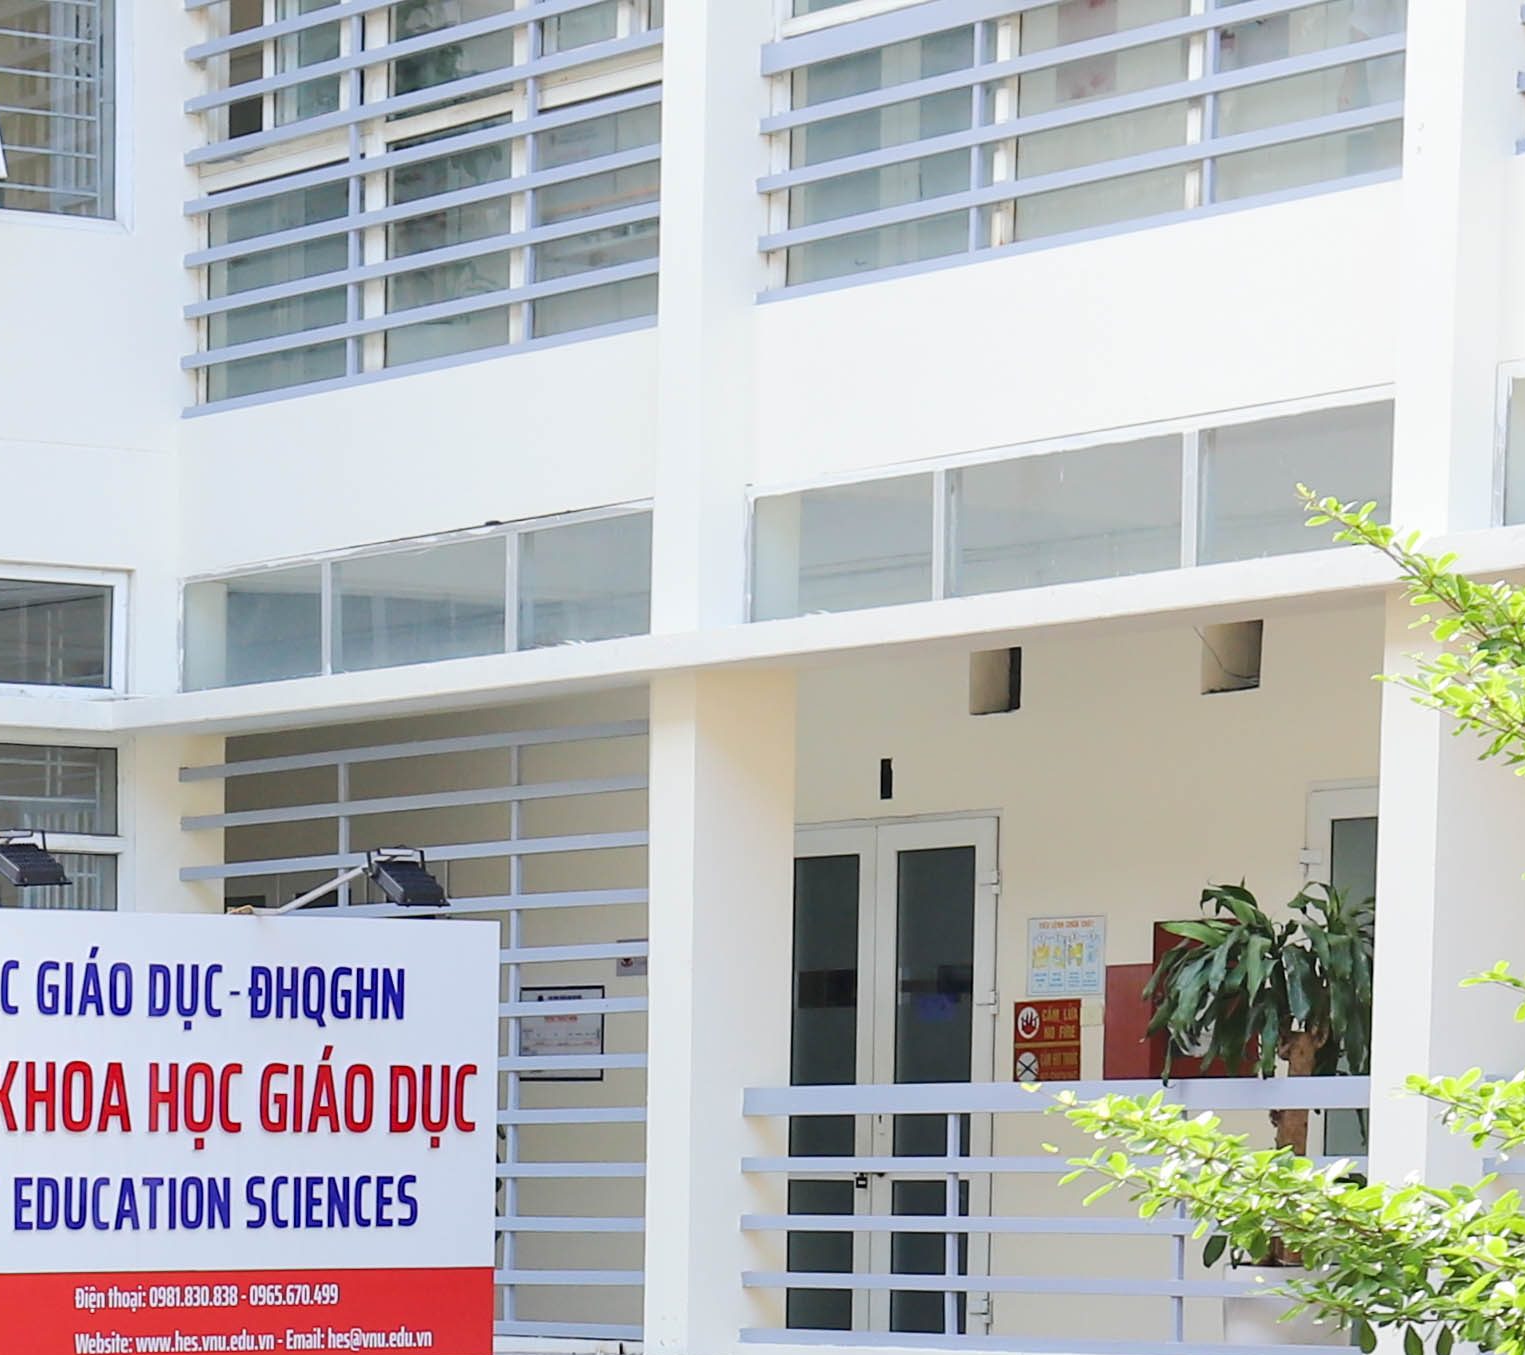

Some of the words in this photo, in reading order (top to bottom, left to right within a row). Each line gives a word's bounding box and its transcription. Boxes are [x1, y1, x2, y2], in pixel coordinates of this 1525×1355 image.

[37, 946, 133, 1017] GIÁO
[148, 963, 223, 1031] DỤC
[248, 965, 405, 1027] ĐHQGHN
[148, 1062, 243, 1151] HỌC
[259, 1045, 374, 1134] GIÁO
[389, 1063, 478, 1149] DỤC
[13, 1175, 231, 1231] EDUCATION
[246, 1174, 418, 1230] SCIENCES
[74, 1285, 106, 1314] Điện
[108, 1285, 146, 1313] thoại:
[149, 1284, 239, 1308] 0981.830.838
[249, 1283, 339, 1306] 0965.670.499
[74, 1331, 133, 1355] Website:
[135, 1329, 275, 1354] www.hes.vnu.edu.vn
[285, 1328, 325, 1351] Email:
[327, 1326, 433, 1352] hes@vnu.edu.vn
